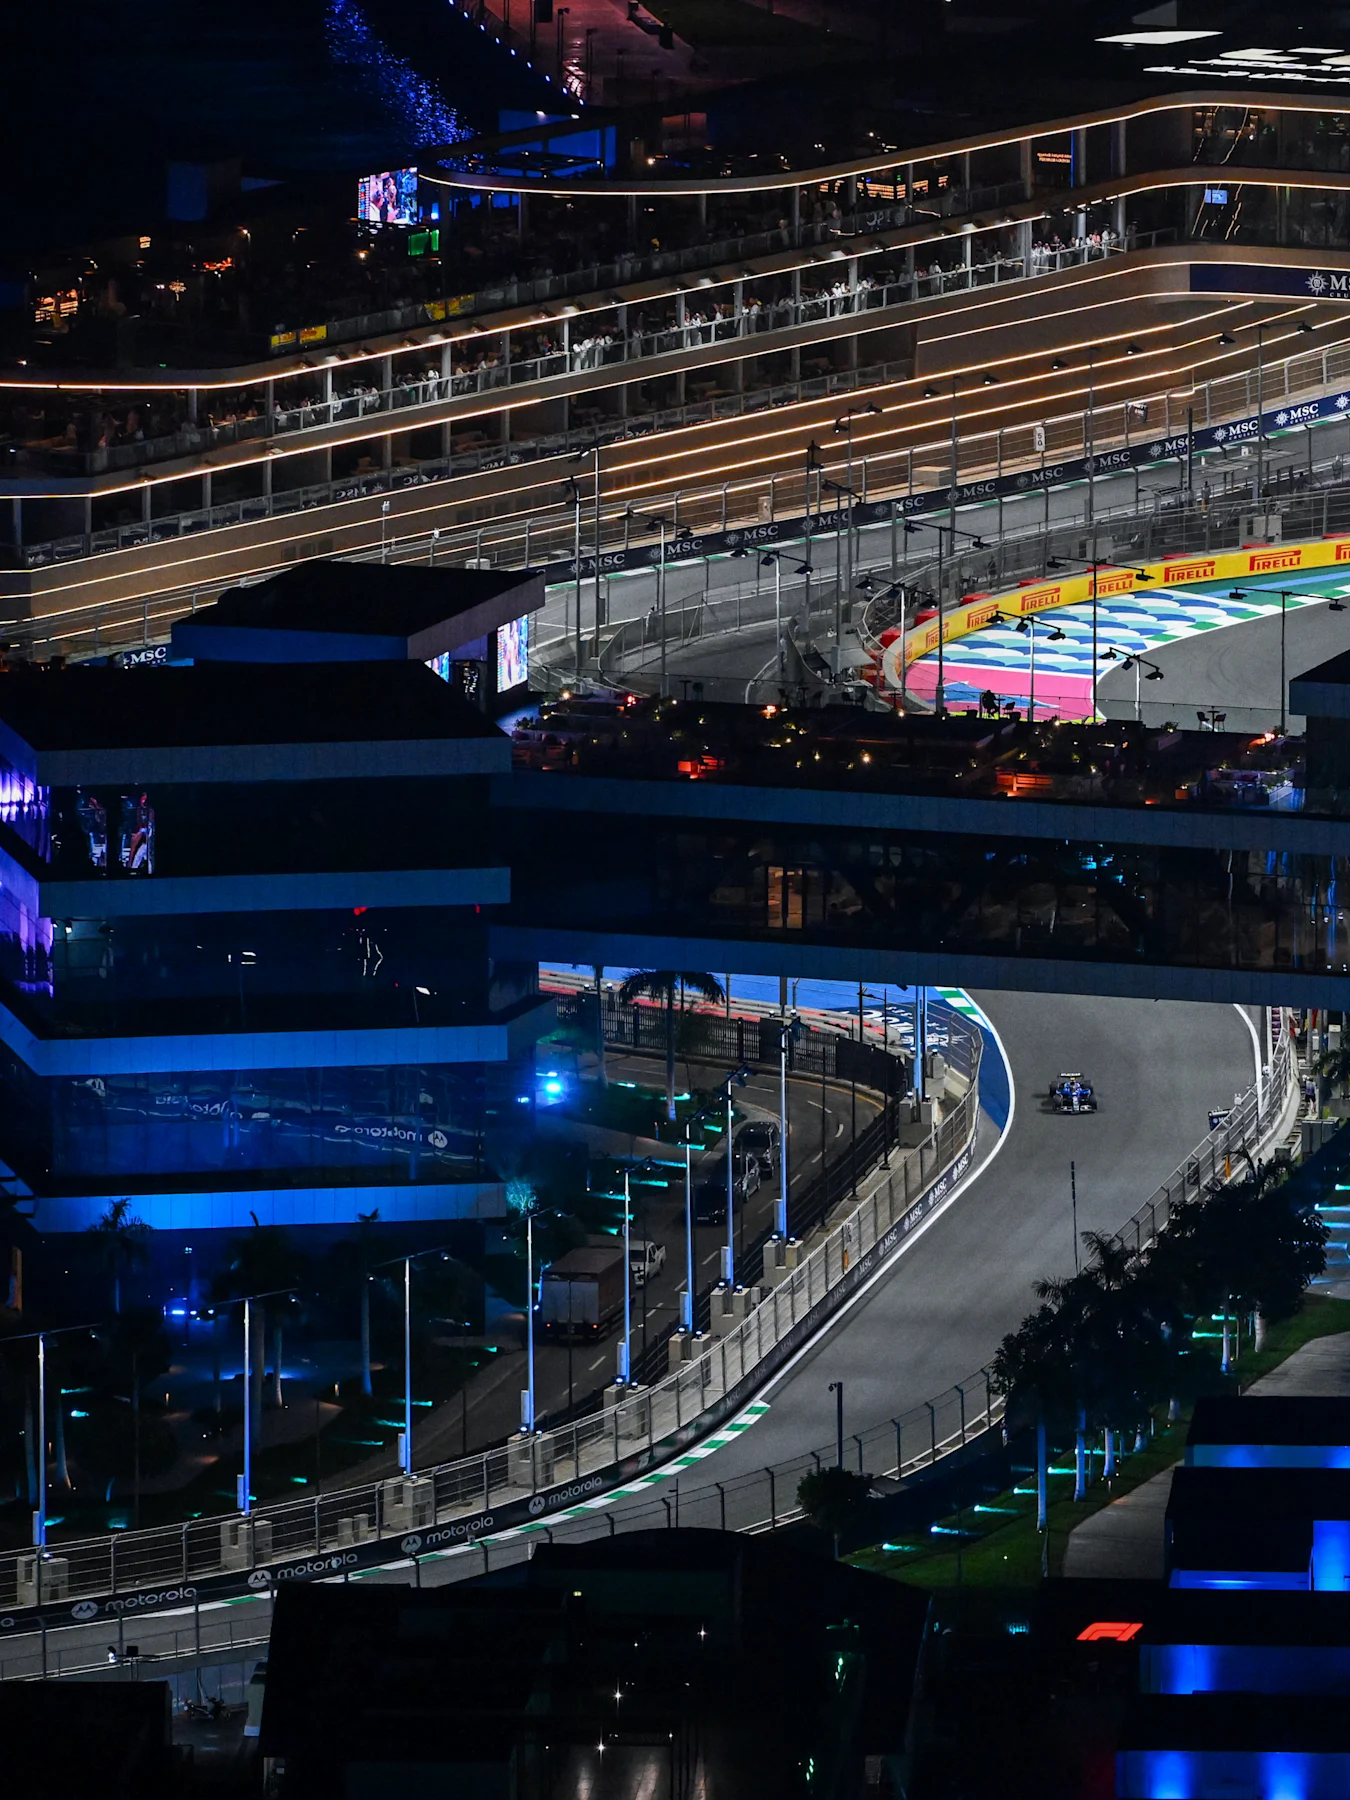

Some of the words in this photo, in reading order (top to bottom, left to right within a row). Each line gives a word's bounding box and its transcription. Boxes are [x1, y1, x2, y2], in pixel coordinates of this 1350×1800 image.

[1290, 403, 1319, 419] MSC
[1228, 419, 1259, 436] MSC
[1164, 436, 1196, 452] MSC
[1099, 451, 1130, 468] MSC
[1031, 467, 1063, 483] MSC
[963, 482, 996, 498] MSC
[743, 525, 778, 542] MSC
[667, 540, 703, 556] MSC
[588, 553, 625, 571] MSC
[1249, 550, 1302, 571] PIRELLI
[1164, 560, 1216, 583] PIRELLI
[1089, 573, 1134, 596] PRELLI
[1021, 587, 1061, 611] PIRELLI
[925, 622, 949, 649] PIRELI
[129, 646, 167, 665] MSC
[957, 1153, 969, 1173] MSC
[934, 1177, 947, 1196] MSC
[909, 1203, 923, 1223] MSC
[884, 1228, 898, 1250] MSC
[859, 1255, 873, 1275] MSC
[548, 1476, 602, 1505] motorola
[426, 1514, 494, 1543] motorola
[277, 1551, 358, 1580] motorola
[105, 1584, 197, 1612] motorola
[1076, 1622, 1143, 1641] F1
